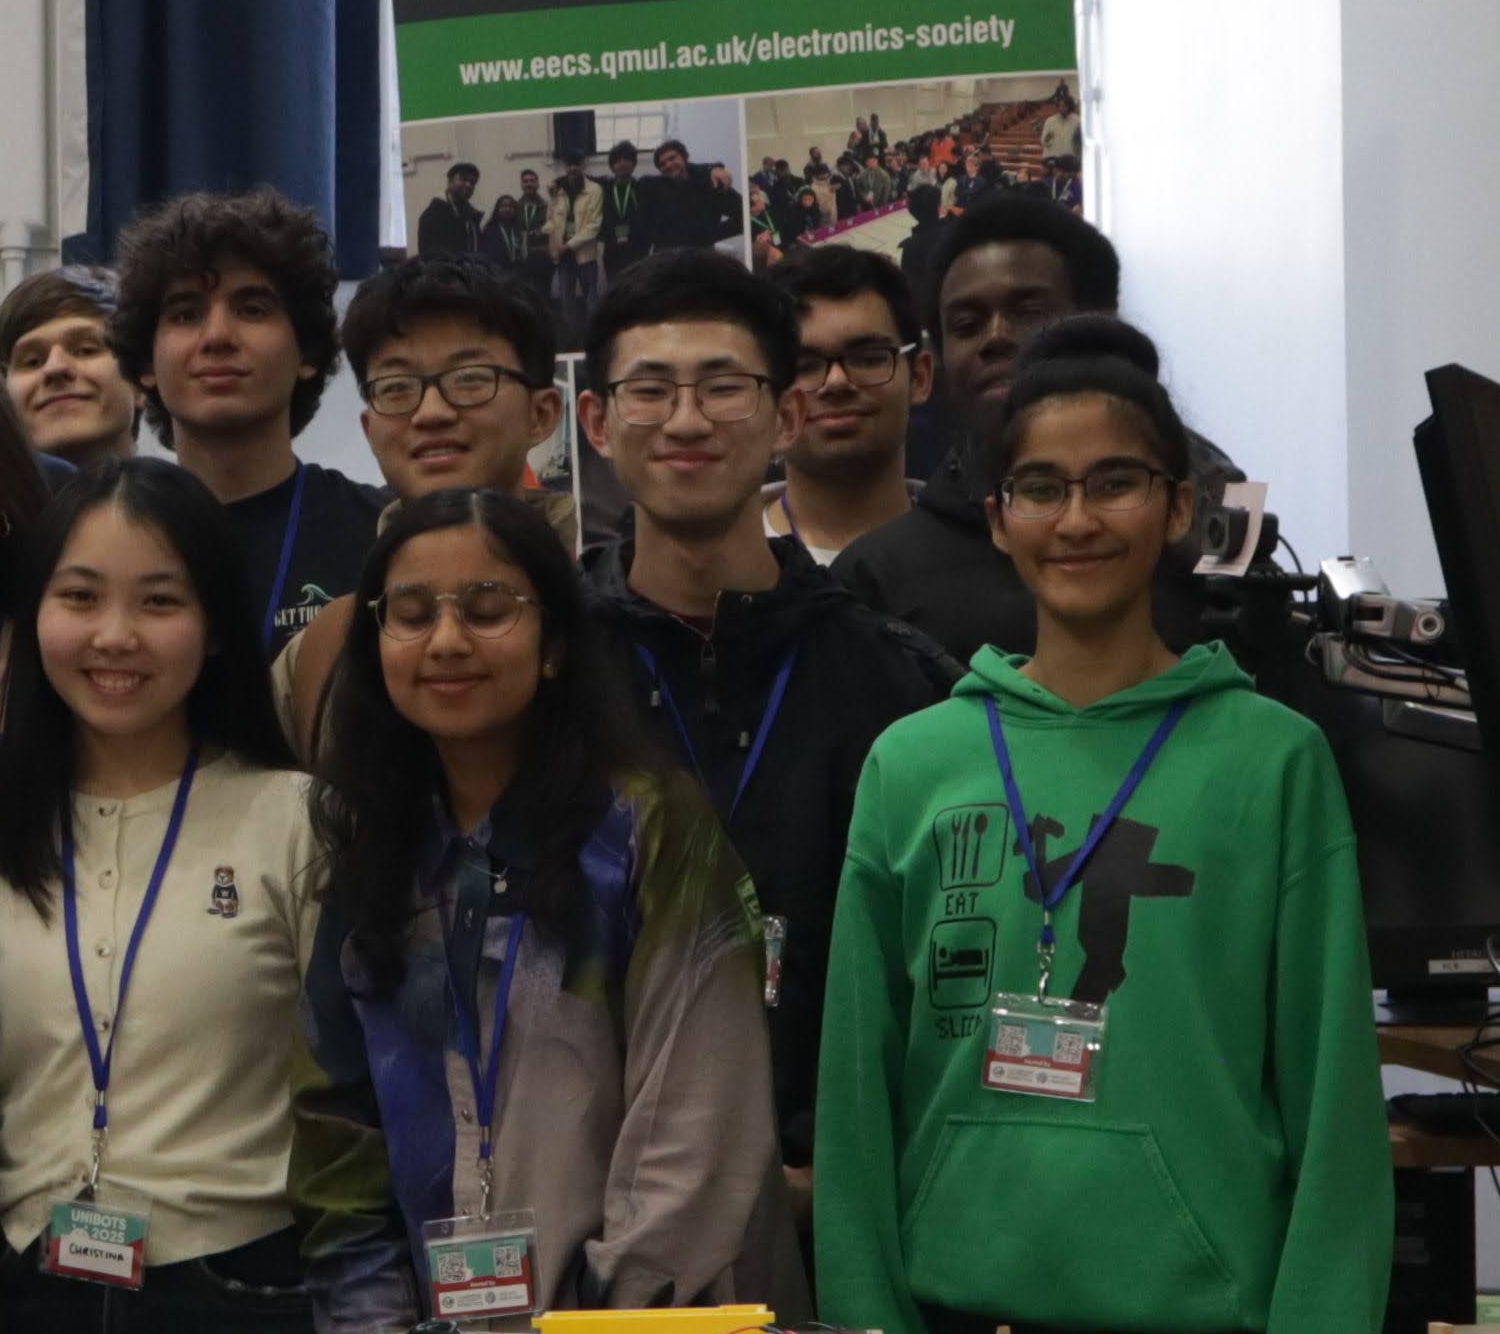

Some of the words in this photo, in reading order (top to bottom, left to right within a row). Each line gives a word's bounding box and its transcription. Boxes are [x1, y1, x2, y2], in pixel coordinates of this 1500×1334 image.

[459, 14, 1015, 86] www.eecs.qmul.ac.uk/electronics-society
[274, 607, 297, 628] GET
[945, 892, 979, 916] EAT
[71, 1208, 127, 1231] UNIBOTS
[91, 1228, 126, 1244] 2025
[68, 1242, 124, 1262] CHRISTINA
